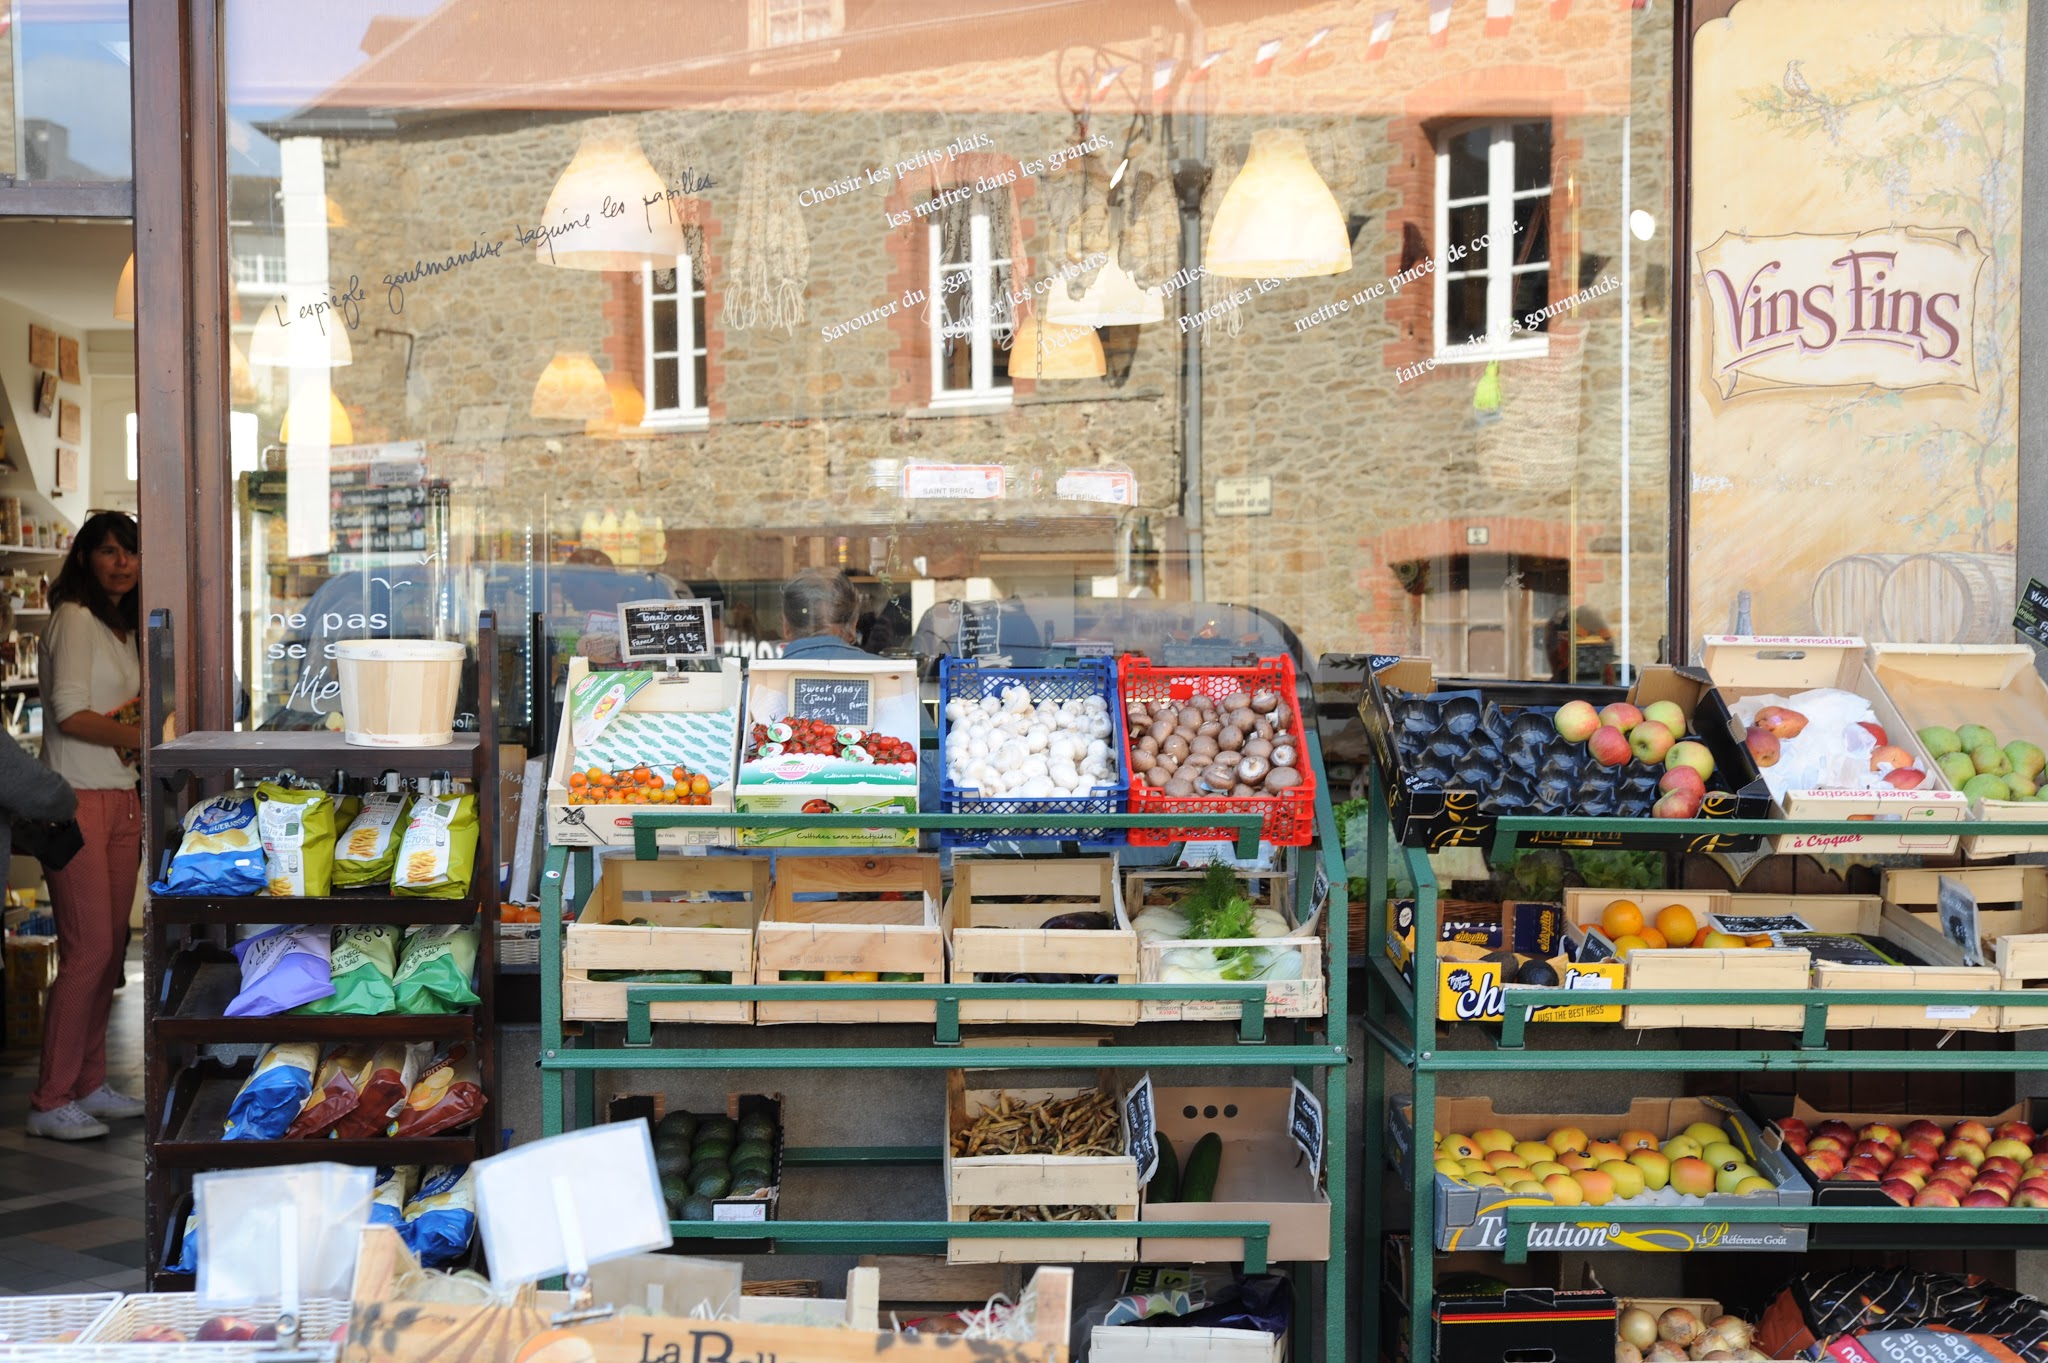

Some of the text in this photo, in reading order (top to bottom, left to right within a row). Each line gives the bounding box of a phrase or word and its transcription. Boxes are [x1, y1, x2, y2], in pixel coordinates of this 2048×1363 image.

[798, 129, 994, 208] Choisir les petits plats,
[885, 135, 1114, 230] les mettre dans les grands,
[382, 231, 503, 314] gourmandise
[516, 208, 592, 264] taquine
[600, 196, 626, 218] les
[642, 167, 718, 233] papilles
[1005, 290, 1031, 308] les
[1294, 299, 1350, 333] mettre
[1352, 283, 1386, 306] une
[1447, 243, 1468, 263] de
[821, 301, 898, 343] Savourer
[902, 286, 926, 309] du
[1177, 288, 1253, 334] Pimenter
[1254, 277, 1280, 294] les
[1706, 249, 1960, 363] Vins Fins
[1040, 316, 1110, 356] Délecte
[1395, 357, 1437, 384] faire
[1525, 274, 1623, 330] gourmands.
[923, 487, 975, 495] SAINT BRIAC
[267, 612, 388, 637] ne pas
[267, 643, 307, 660] se
[1753, 636, 1853, 645] Sweet sensation
[800, 683, 831, 693] Sweet
[1807, 790, 1918, 799] Sweet sensation
[615, 818, 634, 827] PRINC
[1793, 834, 1864, 850] à Croquer
[1537, 1005, 1604, 1022] JUST THE BEST HASS
[1477, 1216, 1621, 1249] Tetation®
[1696, 1233, 1787, 1246] La Référence Goût
[640, 1330, 798, 1363] La Bll
